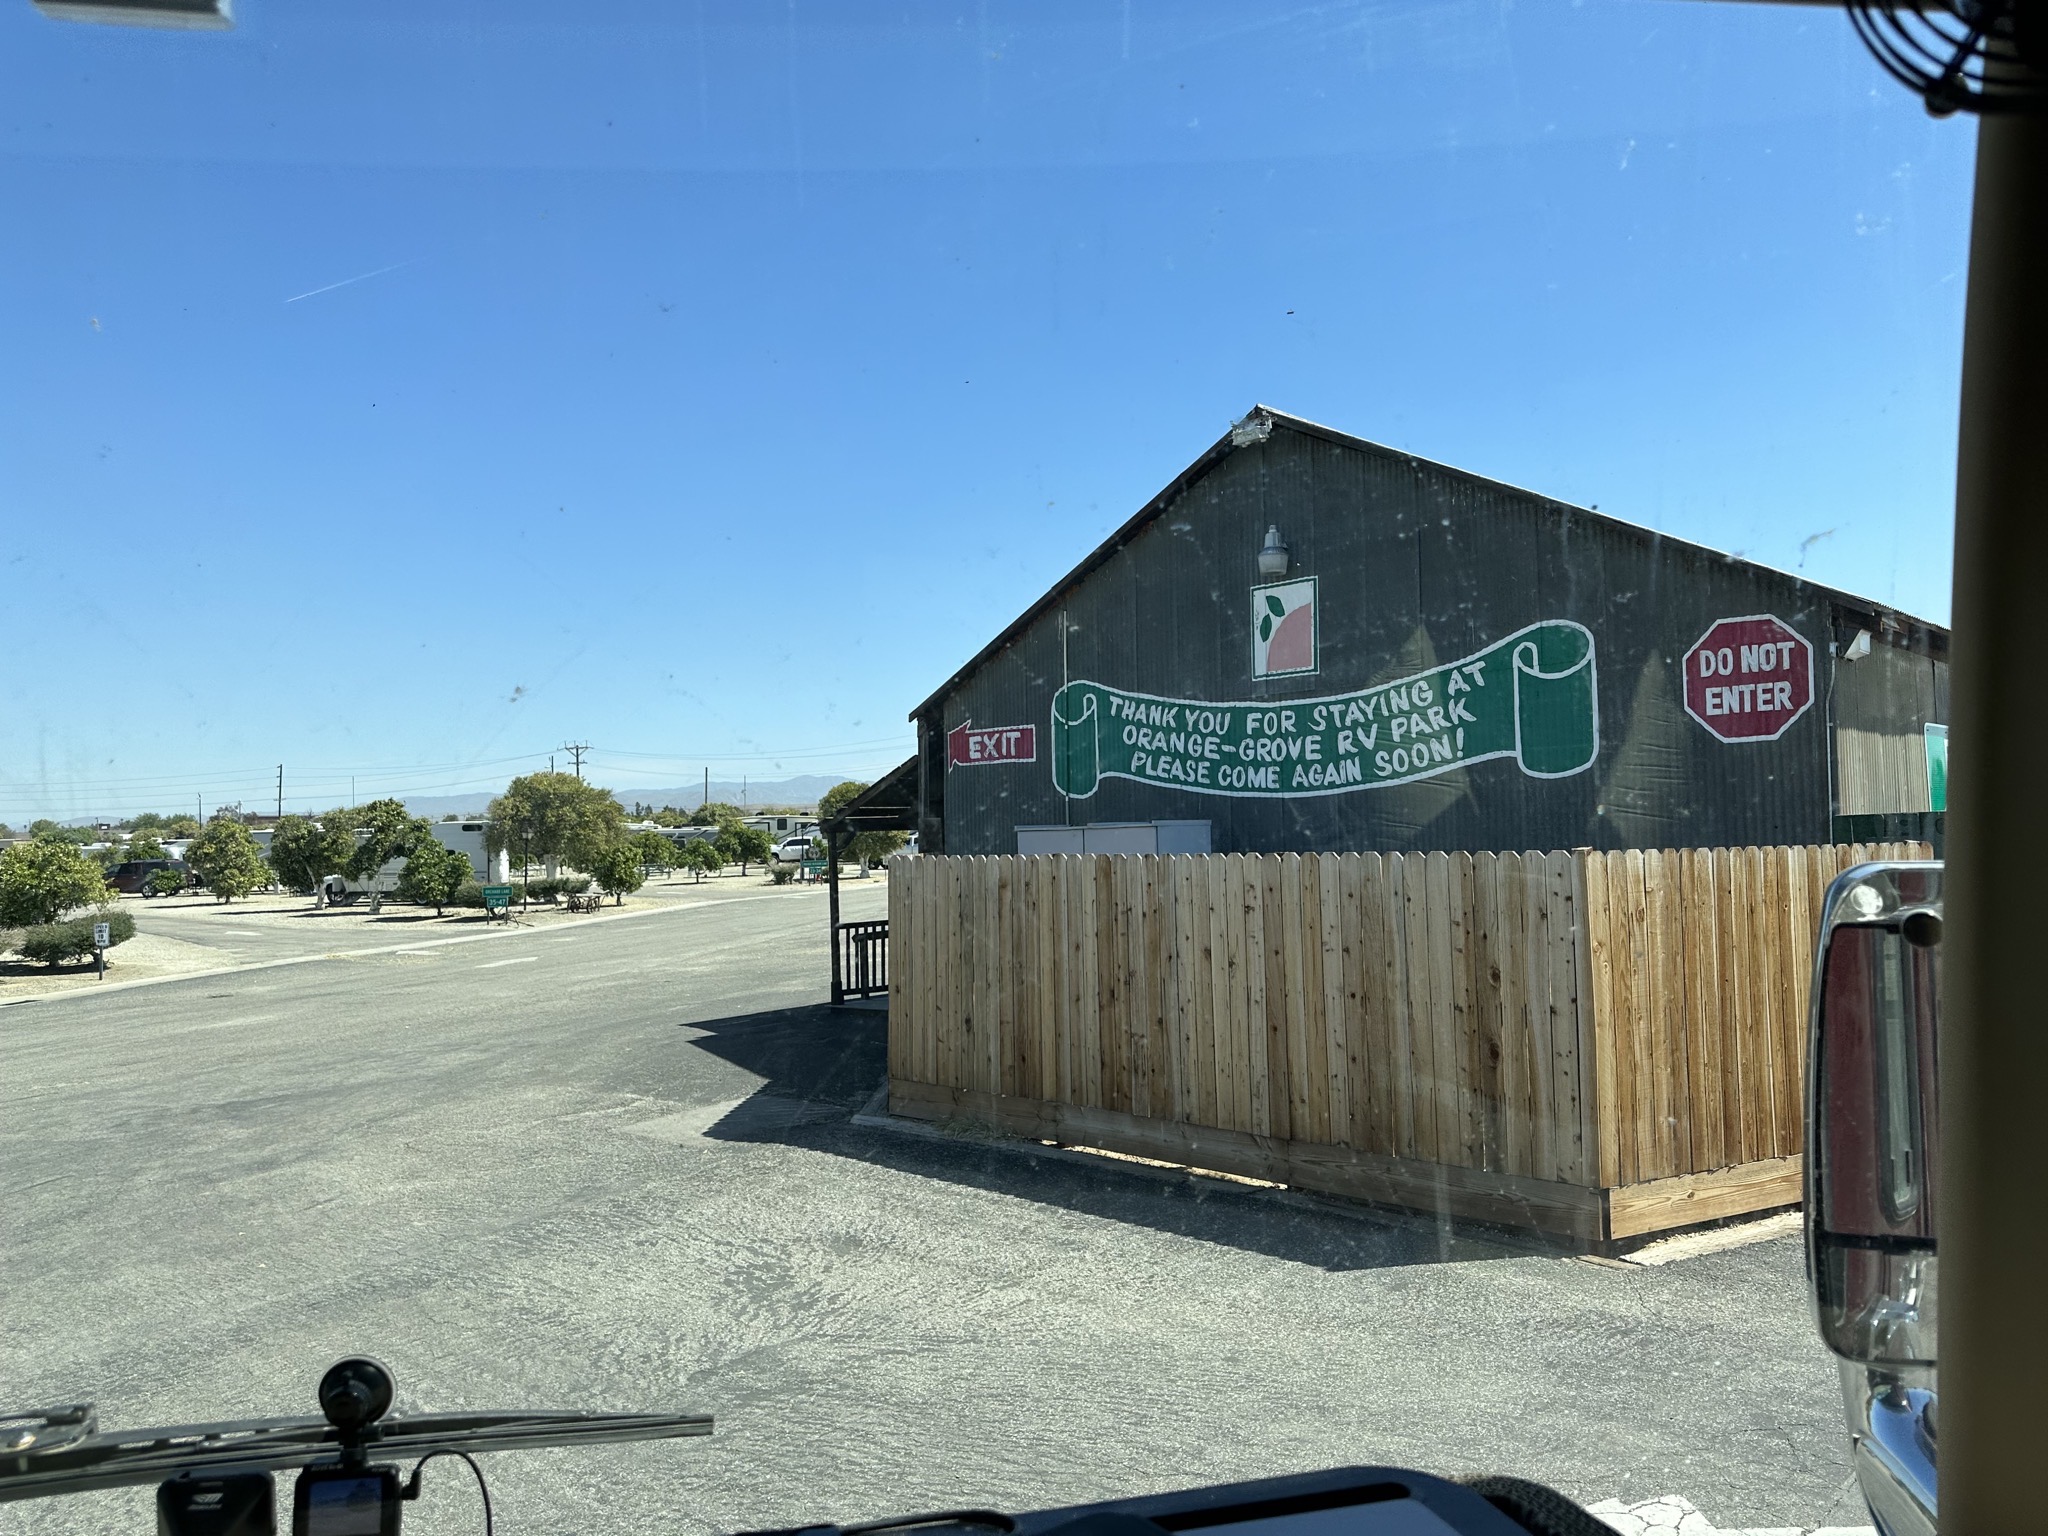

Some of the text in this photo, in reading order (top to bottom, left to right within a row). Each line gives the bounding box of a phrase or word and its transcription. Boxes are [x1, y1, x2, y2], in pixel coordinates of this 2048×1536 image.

[1700, 641, 1795, 678] DO NOT
[1109, 661, 1486, 735] THANK YOU FOR STAYING AT
[1705, 681, 1794, 716] ENTER
[969, 731, 1021, 759] EXIT
[1122, 698, 1477, 762] ORANGE-GROVE RV PARK
[1130, 727, 1465, 789] PLEASE COME AGAIN SOON!
[489, 898, 506, 906] 35-47
